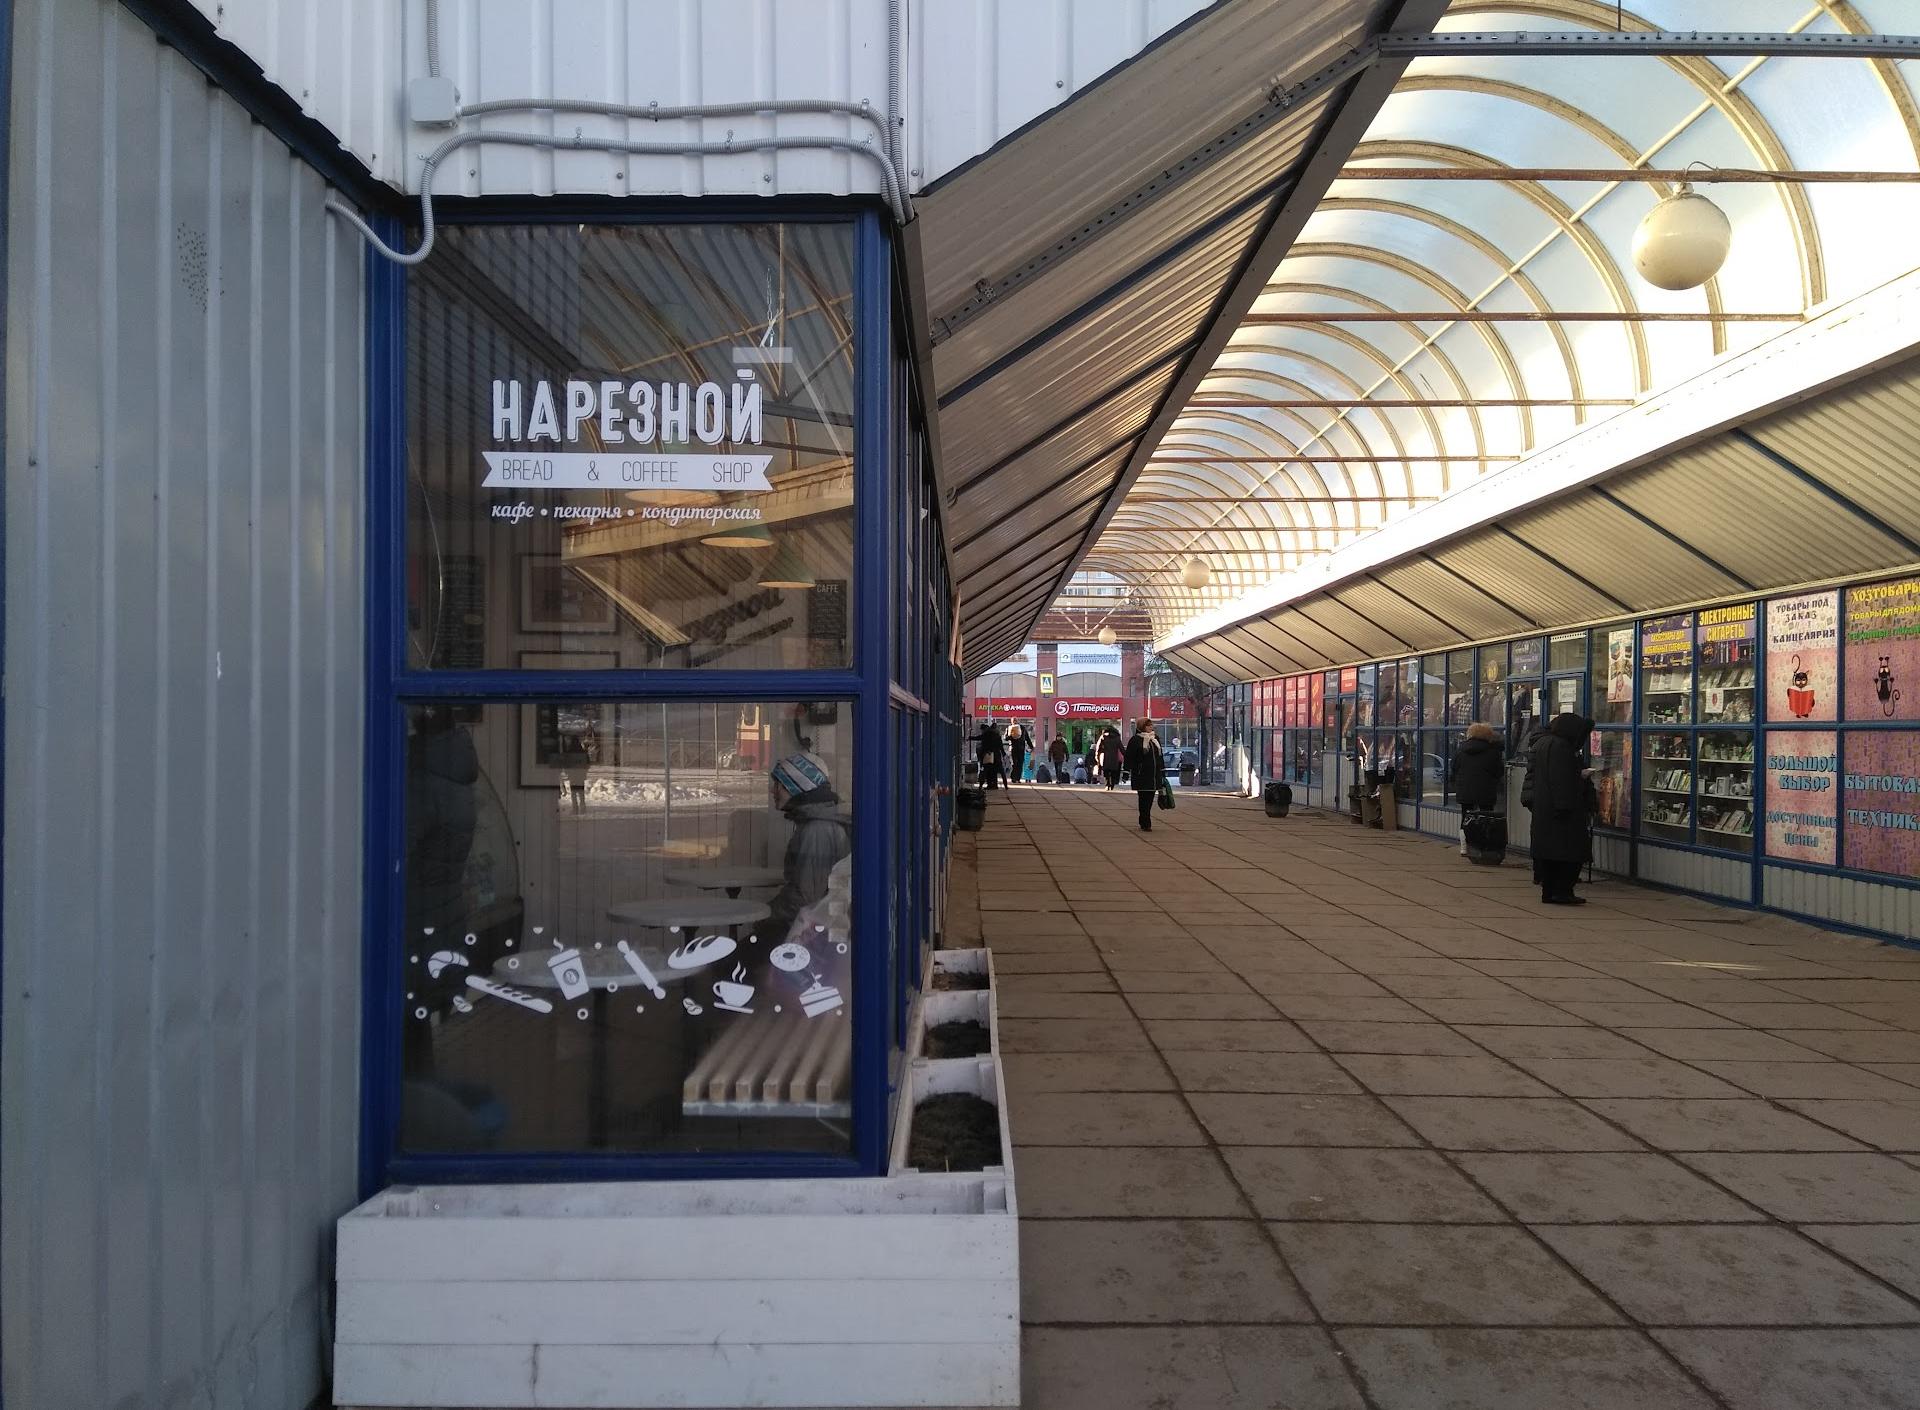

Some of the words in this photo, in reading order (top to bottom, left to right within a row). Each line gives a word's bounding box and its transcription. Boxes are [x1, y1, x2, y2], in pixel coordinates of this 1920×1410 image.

[492, 369, 763, 445] НАРЕЗНОЙ
[502, 459, 553, 481] BREAD
[587, 461, 599, 481] &
[622, 461, 678, 482] COFFEE
[712, 462, 753, 483] SHOP
[491, 502, 534, 525] кафе
[553, 505, 622, 526] пекарня
[641, 506, 761, 527] кондитерская
[1699, 603, 1755, 625] ЭЛЕКТРОННЫЕ
[1776, 602, 1810, 613] ТОВАРЫ
[1811, 598, 1829, 608] ПОД
[1785, 610, 1817, 623] ЗАКАЗ
[1851, 610, 1882, 620] ТОВАРЫ
[1707, 623, 1746, 641] СИГАРЕТЫ
[1773, 628, 1836, 644] КАНЦЕЛЯРИЯ
[1768, 754, 1837, 772] БОЛЬШОЙ
[1780, 775, 1830, 792] ВЫБОР
[1847, 809, 1920, 831] ТЕХНИК
